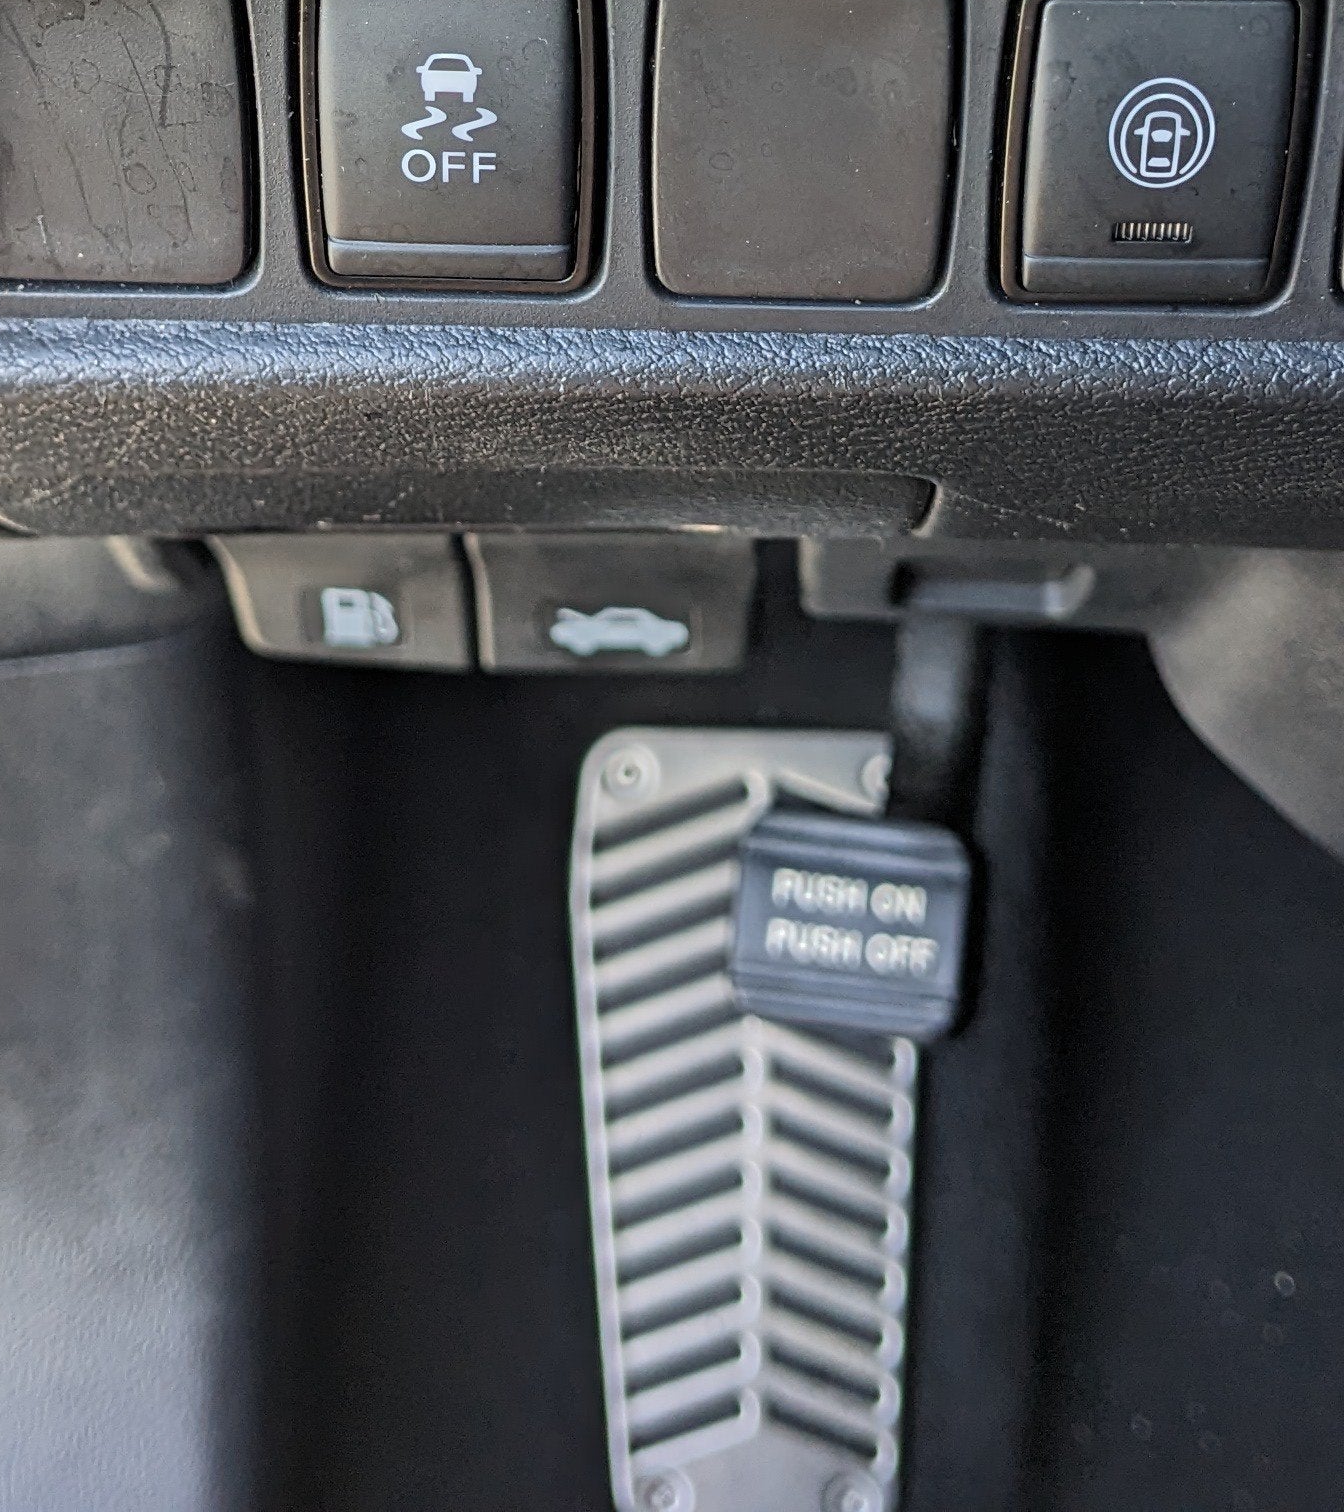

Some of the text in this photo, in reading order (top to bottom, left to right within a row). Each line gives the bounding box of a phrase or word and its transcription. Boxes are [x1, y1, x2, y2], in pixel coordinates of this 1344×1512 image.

[401, 149, 497, 184] OFF
[771, 867, 927, 928] PUSH ON
[764, 917, 940, 978] PUSH OFF
